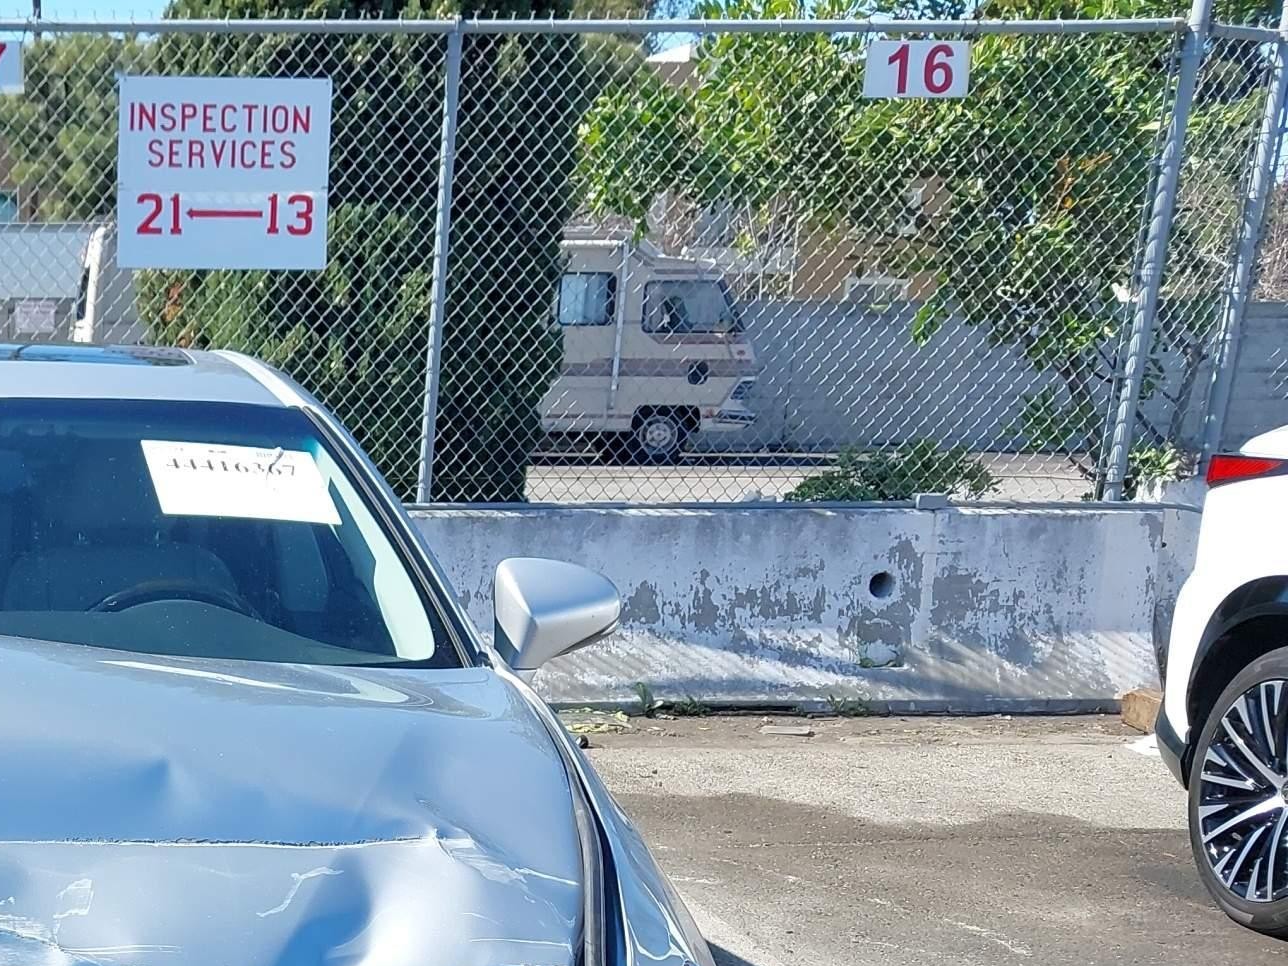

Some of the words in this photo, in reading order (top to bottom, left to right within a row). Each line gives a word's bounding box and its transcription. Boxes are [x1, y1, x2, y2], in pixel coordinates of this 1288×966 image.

[888, 44, 954, 94] 16
[128, 103, 312, 134] INSPECTION
[147, 139, 297, 169] SERVICES
[136, 193, 182, 236] 21
[266, 193, 314, 236] 13
